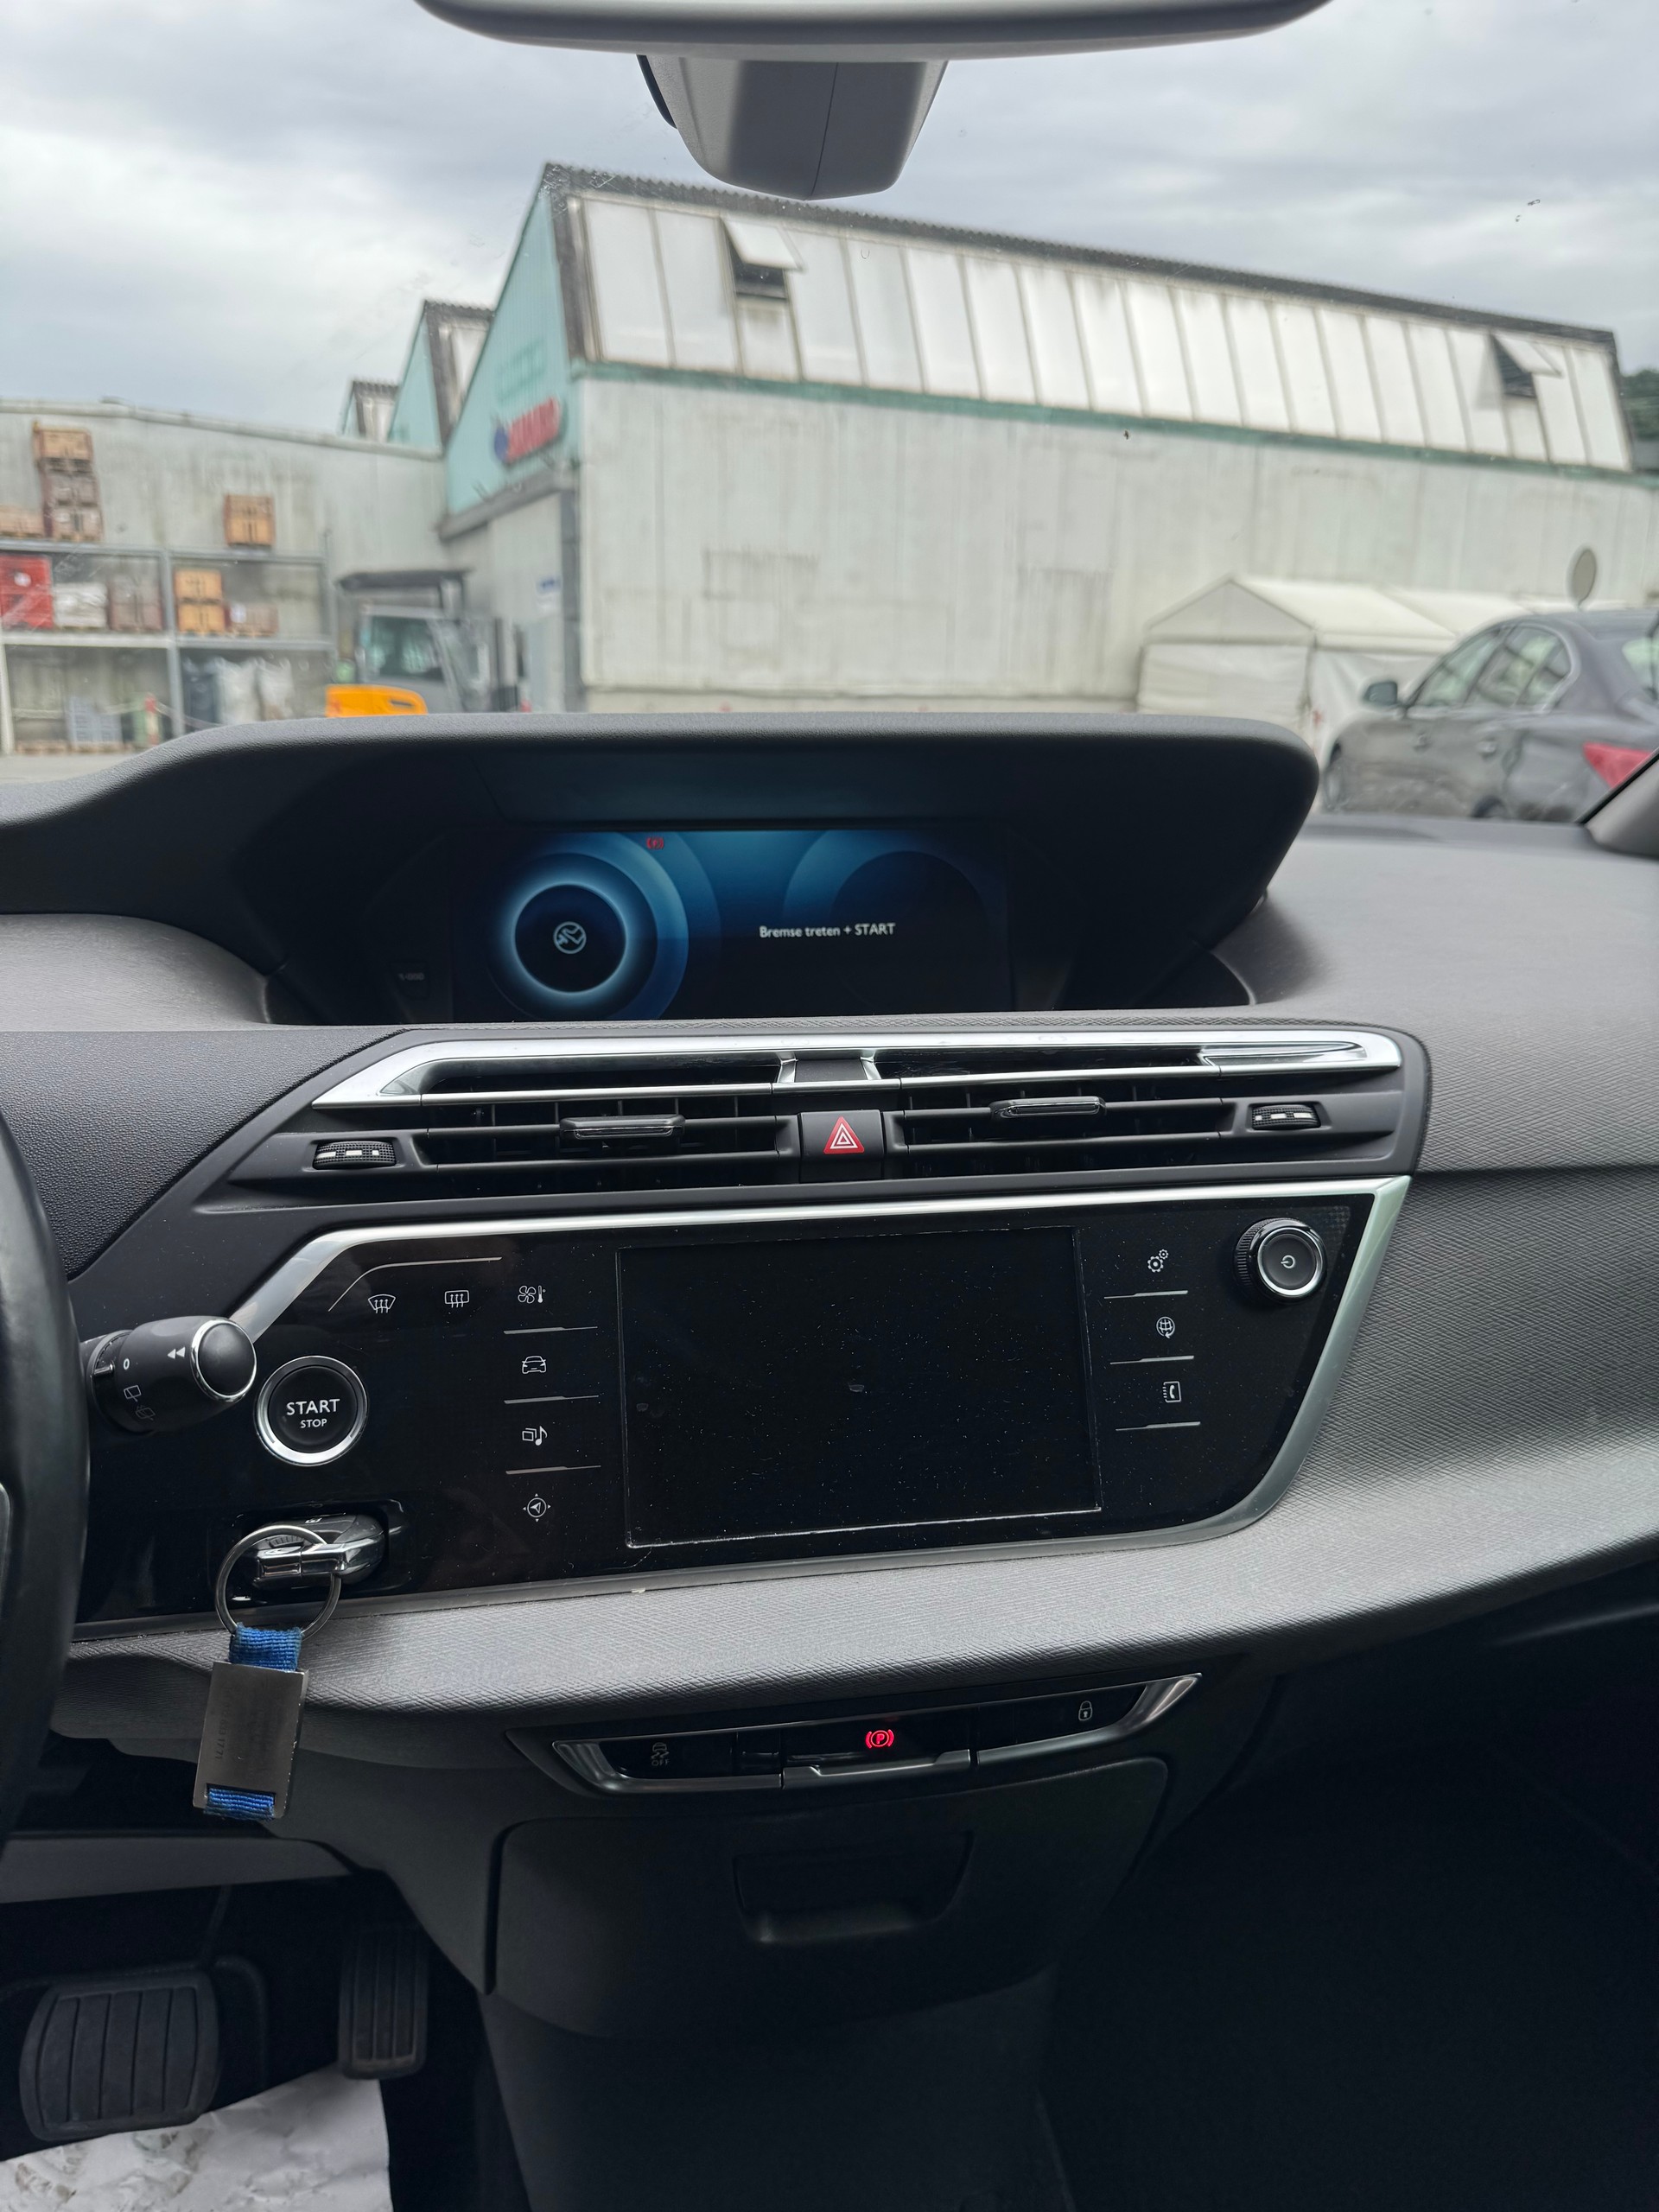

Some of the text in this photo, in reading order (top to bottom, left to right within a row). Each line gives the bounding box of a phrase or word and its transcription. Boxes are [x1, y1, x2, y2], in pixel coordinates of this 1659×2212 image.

[759, 925, 803, 938] Bremse
[804, 925, 841, 938] treten
[854, 922, 896, 936] START
[286, 1398, 340, 1416] START
[300, 1417, 328, 1429] STOP
[651, 1758, 671, 1767] OFF
